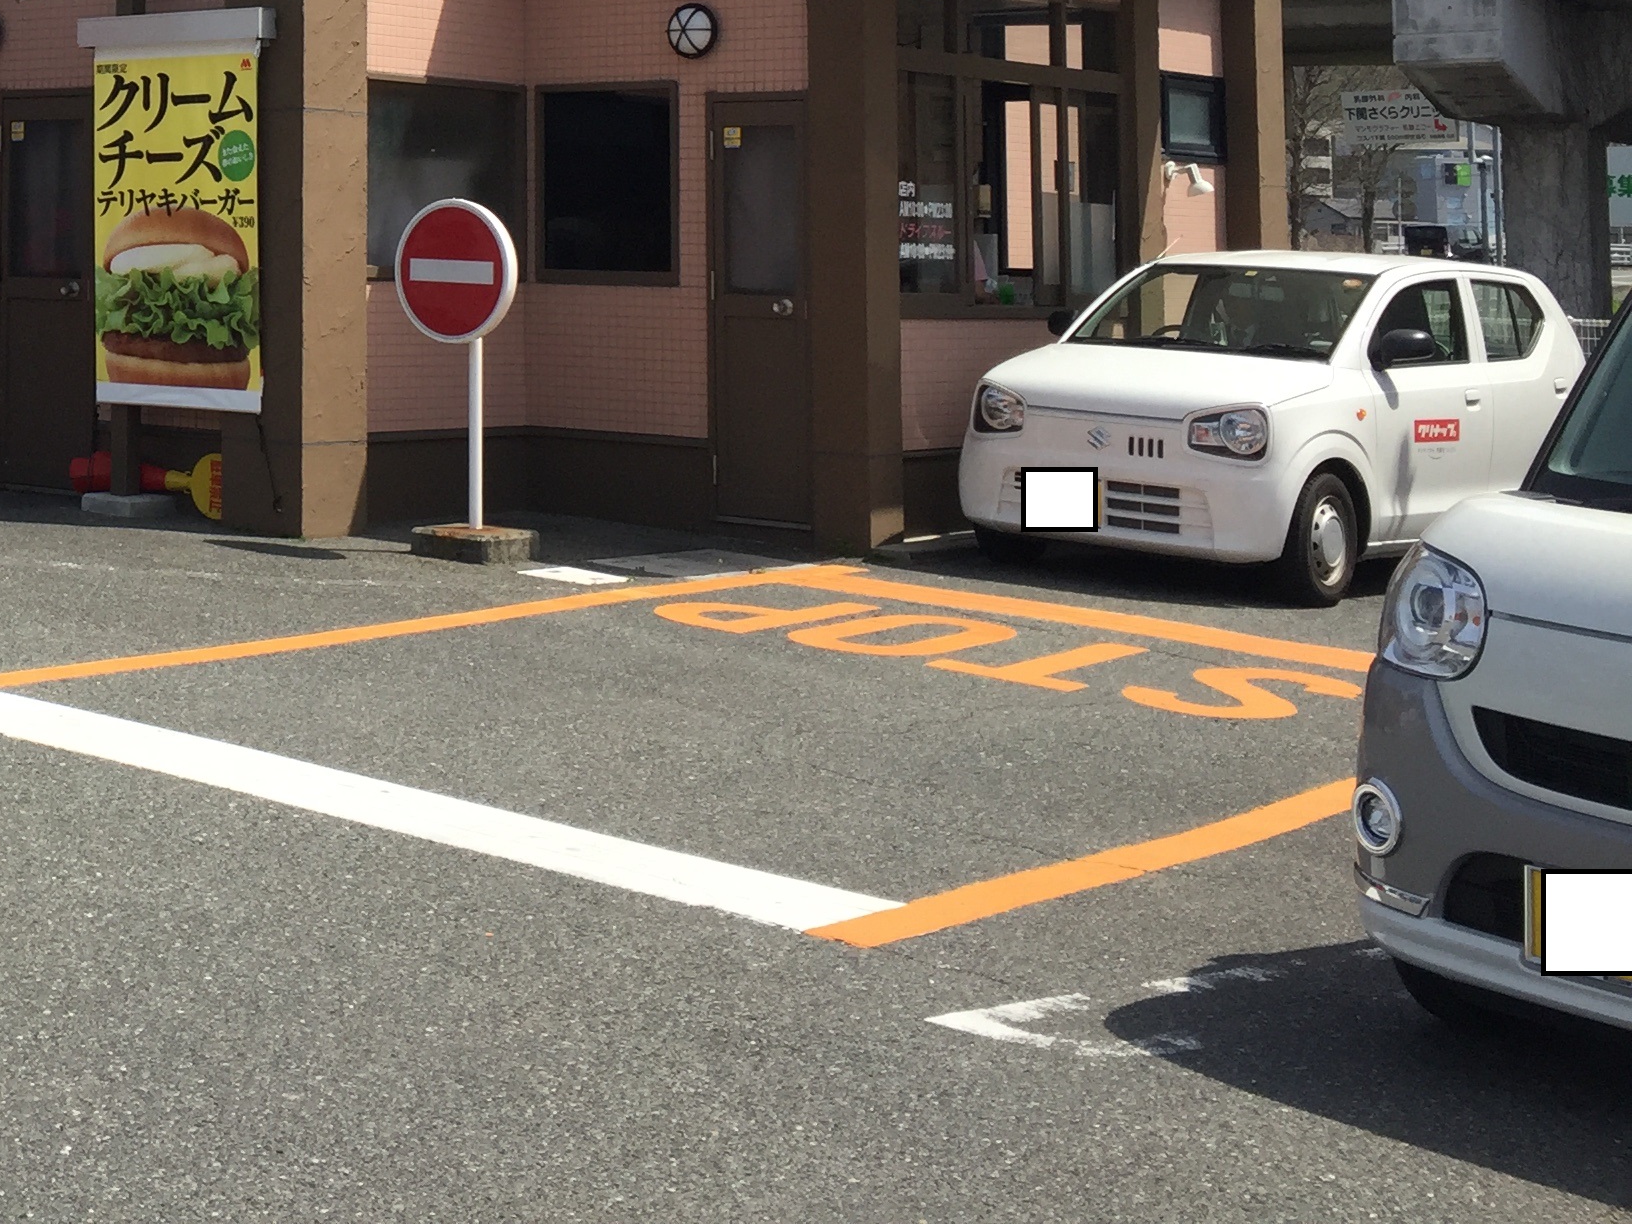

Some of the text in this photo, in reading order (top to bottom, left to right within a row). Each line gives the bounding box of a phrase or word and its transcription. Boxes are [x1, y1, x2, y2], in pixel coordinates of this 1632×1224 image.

[97, 71, 254, 134] クリーム
[1344, 105, 1441, 121] 下関さくらクリニッ
[98, 125, 226, 189] チーズ
[97, 187, 255, 217] テリヤキバーガー
[232, 216, 255, 228] ¥390
[653, 600, 1363, 720] STOP
